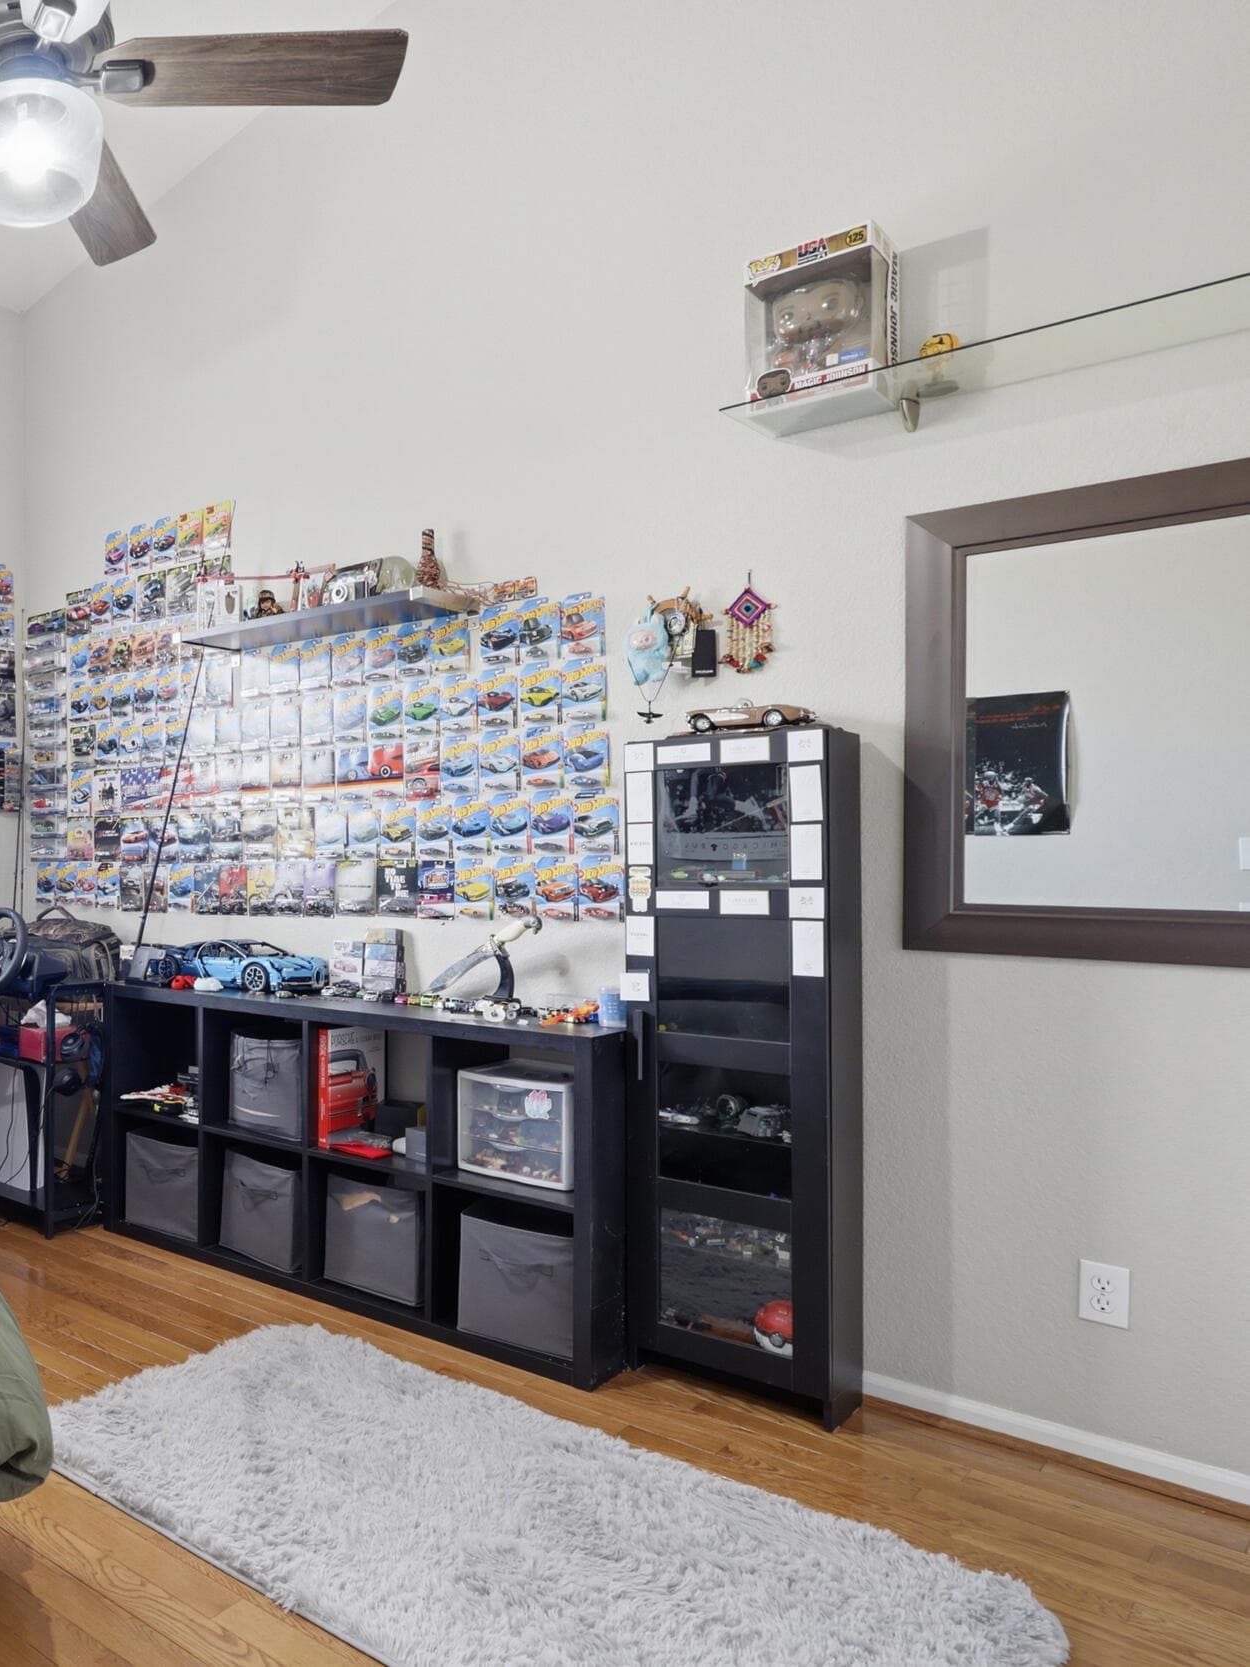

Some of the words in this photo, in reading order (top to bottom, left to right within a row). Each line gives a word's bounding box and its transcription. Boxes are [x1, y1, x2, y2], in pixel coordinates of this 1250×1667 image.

[847, 230, 864, 243] 125
[890, 252, 899, 303] MAGIC
[795, 377, 822, 389] MAGIC
[823, 365, 865, 383] JOHNSON
